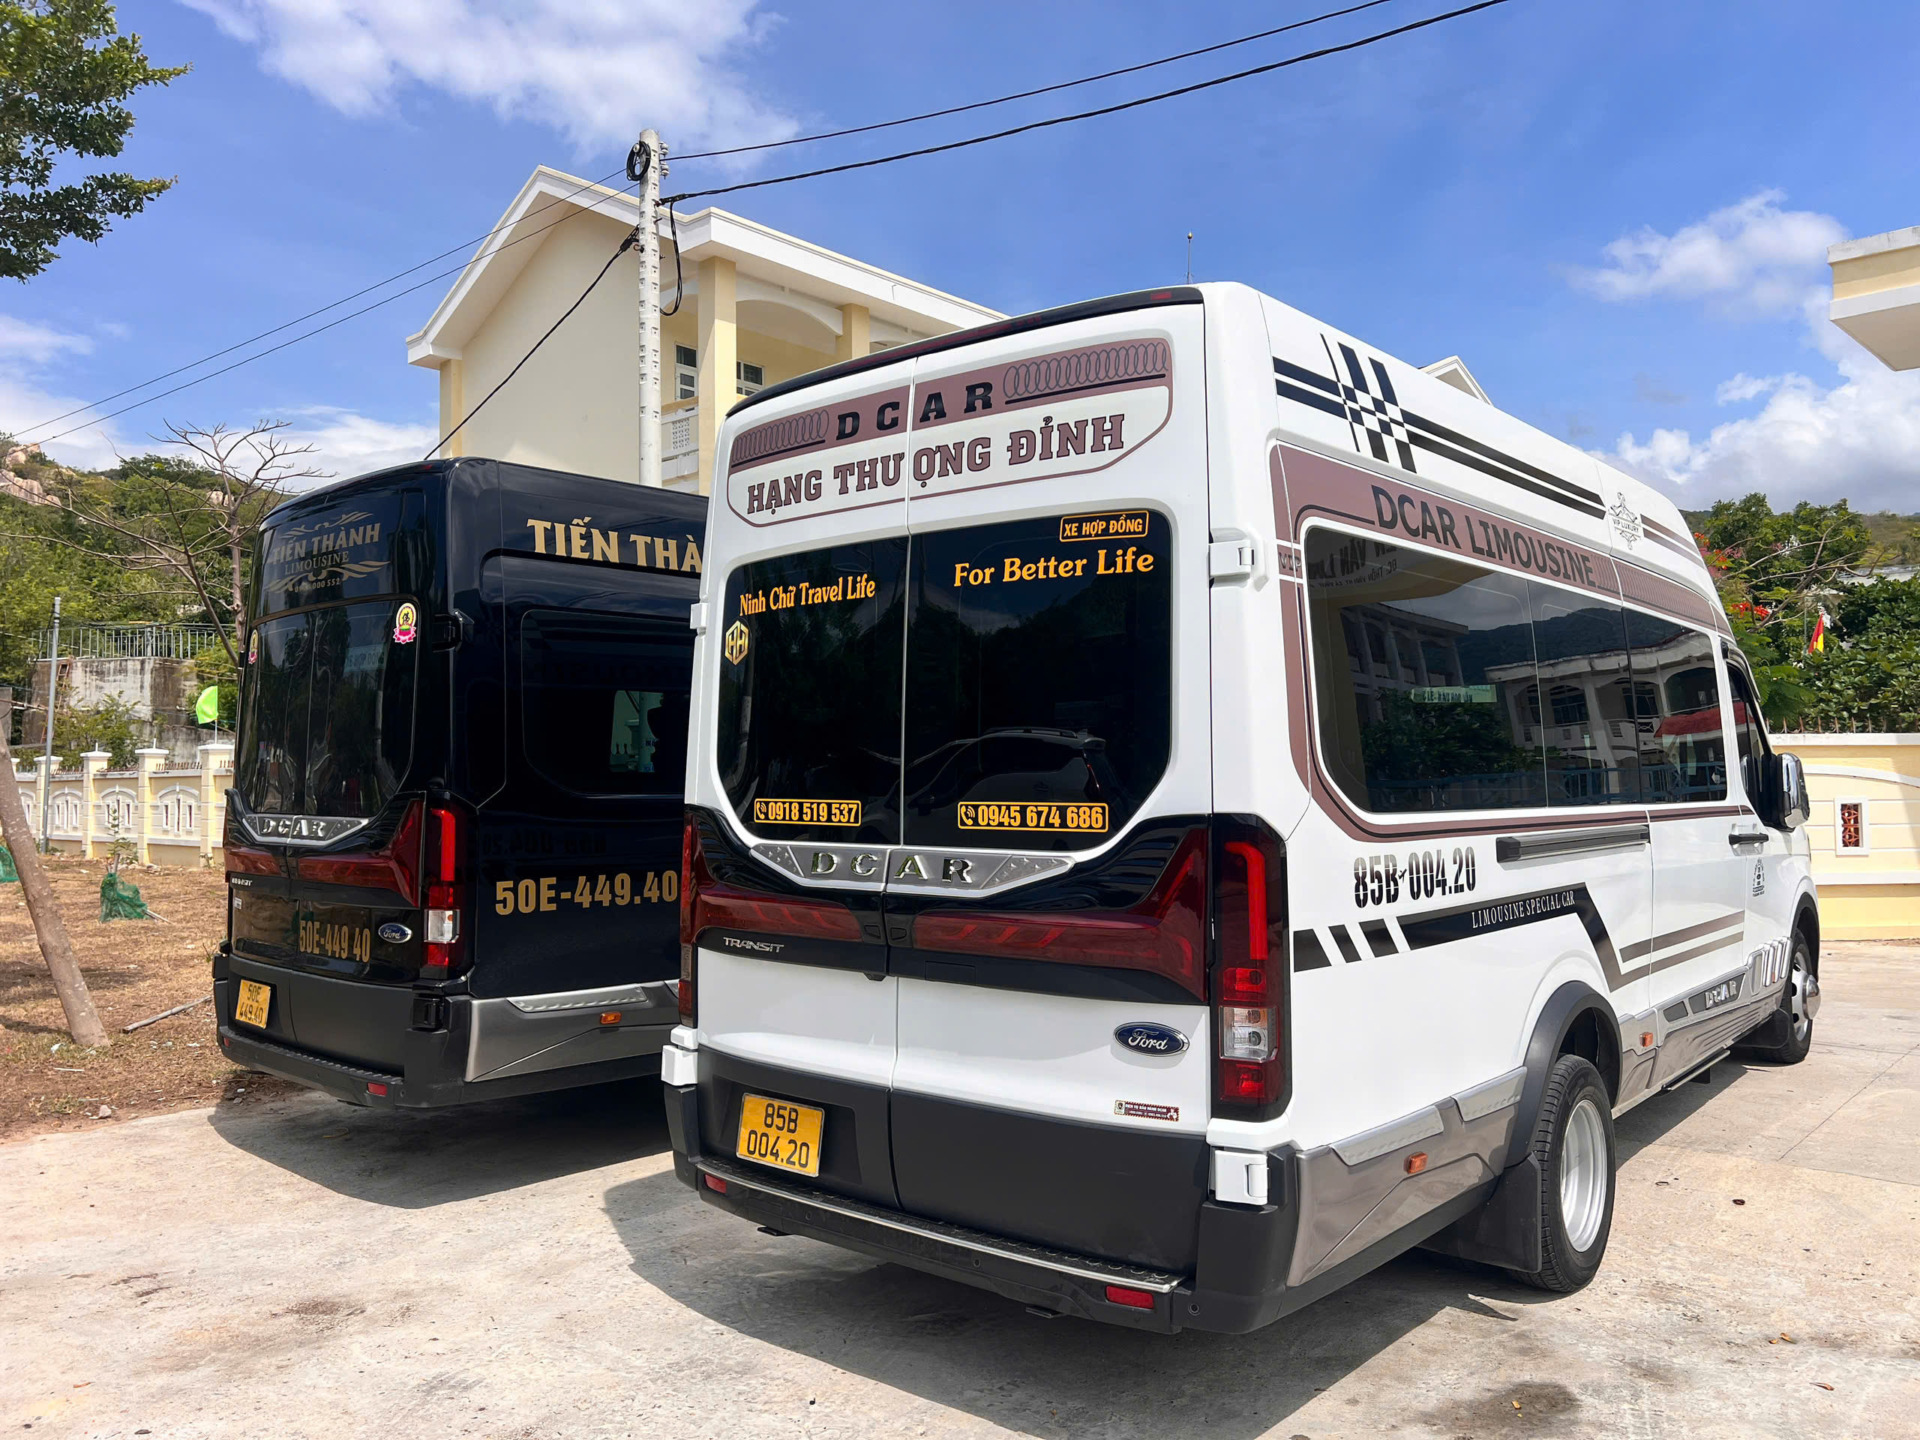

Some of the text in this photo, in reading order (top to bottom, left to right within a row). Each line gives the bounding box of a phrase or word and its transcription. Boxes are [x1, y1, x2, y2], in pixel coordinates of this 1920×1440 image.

[836, 382, 994, 441] DCAR
[747, 470, 822, 515] HẠNG
[1007, 415, 1125, 466] ĐỈNH
[526, 516, 620, 563] TIẾN
[1064, 514, 1143, 537] XE HỢP ĐỒNG
[1371, 485, 1597, 588] DCAR LIMOUSINE
[272, 523, 380, 565] TIẾN THÀNH
[284, 551, 349, 575] LIMOUSINE
[953, 546, 1154, 587] For Better Life
[1279, 551, 1302, 572] VIP
[739, 573, 876, 616] Ninh Chữ Travel Life
[262, 818, 328, 838] DCAR
[768, 801, 858, 823] 0918 519 537
[977, 805, 1104, 828] 0945 674 686
[810, 852, 973, 883] DCAR
[495, 870, 678, 915] 50E-449.40
[1472, 890, 1576, 929] LIMOUSINE SPECIAL CAR
[723, 937, 784, 953] TRANSIT
[1704, 980, 1737, 1010] DCAR
[1128, 1028, 1169, 1050] Ford
[763, 1102, 799, 1134] 85B
[746, 1129, 810, 1169] 004.20
